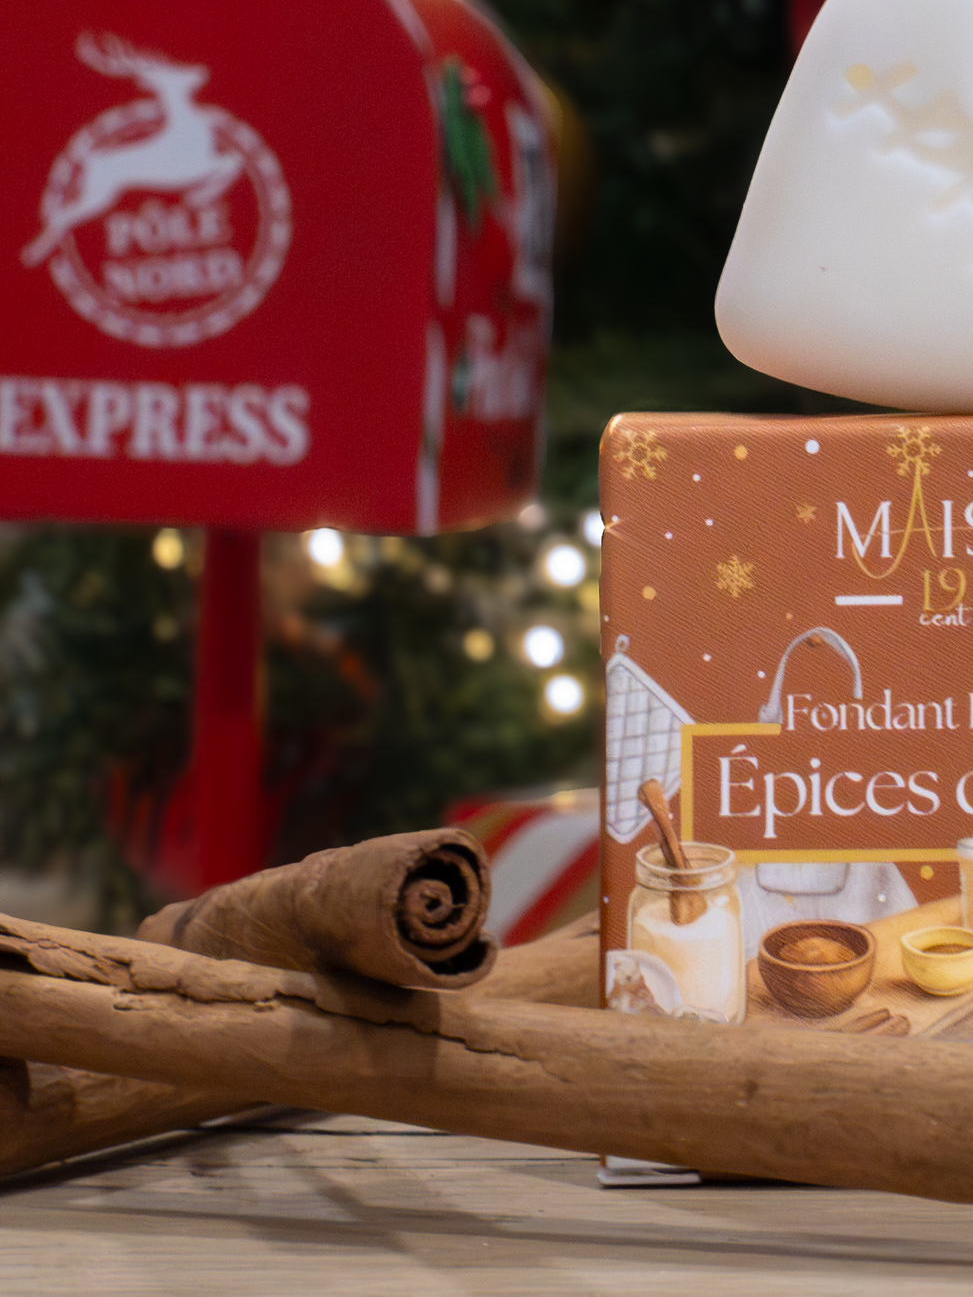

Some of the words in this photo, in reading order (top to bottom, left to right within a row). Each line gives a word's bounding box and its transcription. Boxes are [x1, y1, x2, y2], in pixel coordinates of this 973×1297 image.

[105, 251, 245, 299] NORD
[0, 378, 311, 464] EXPRESS
[918, 603, 973, 627] cent
[785, 689, 959, 731] Fondant
[718, 744, 942, 839] Épices
